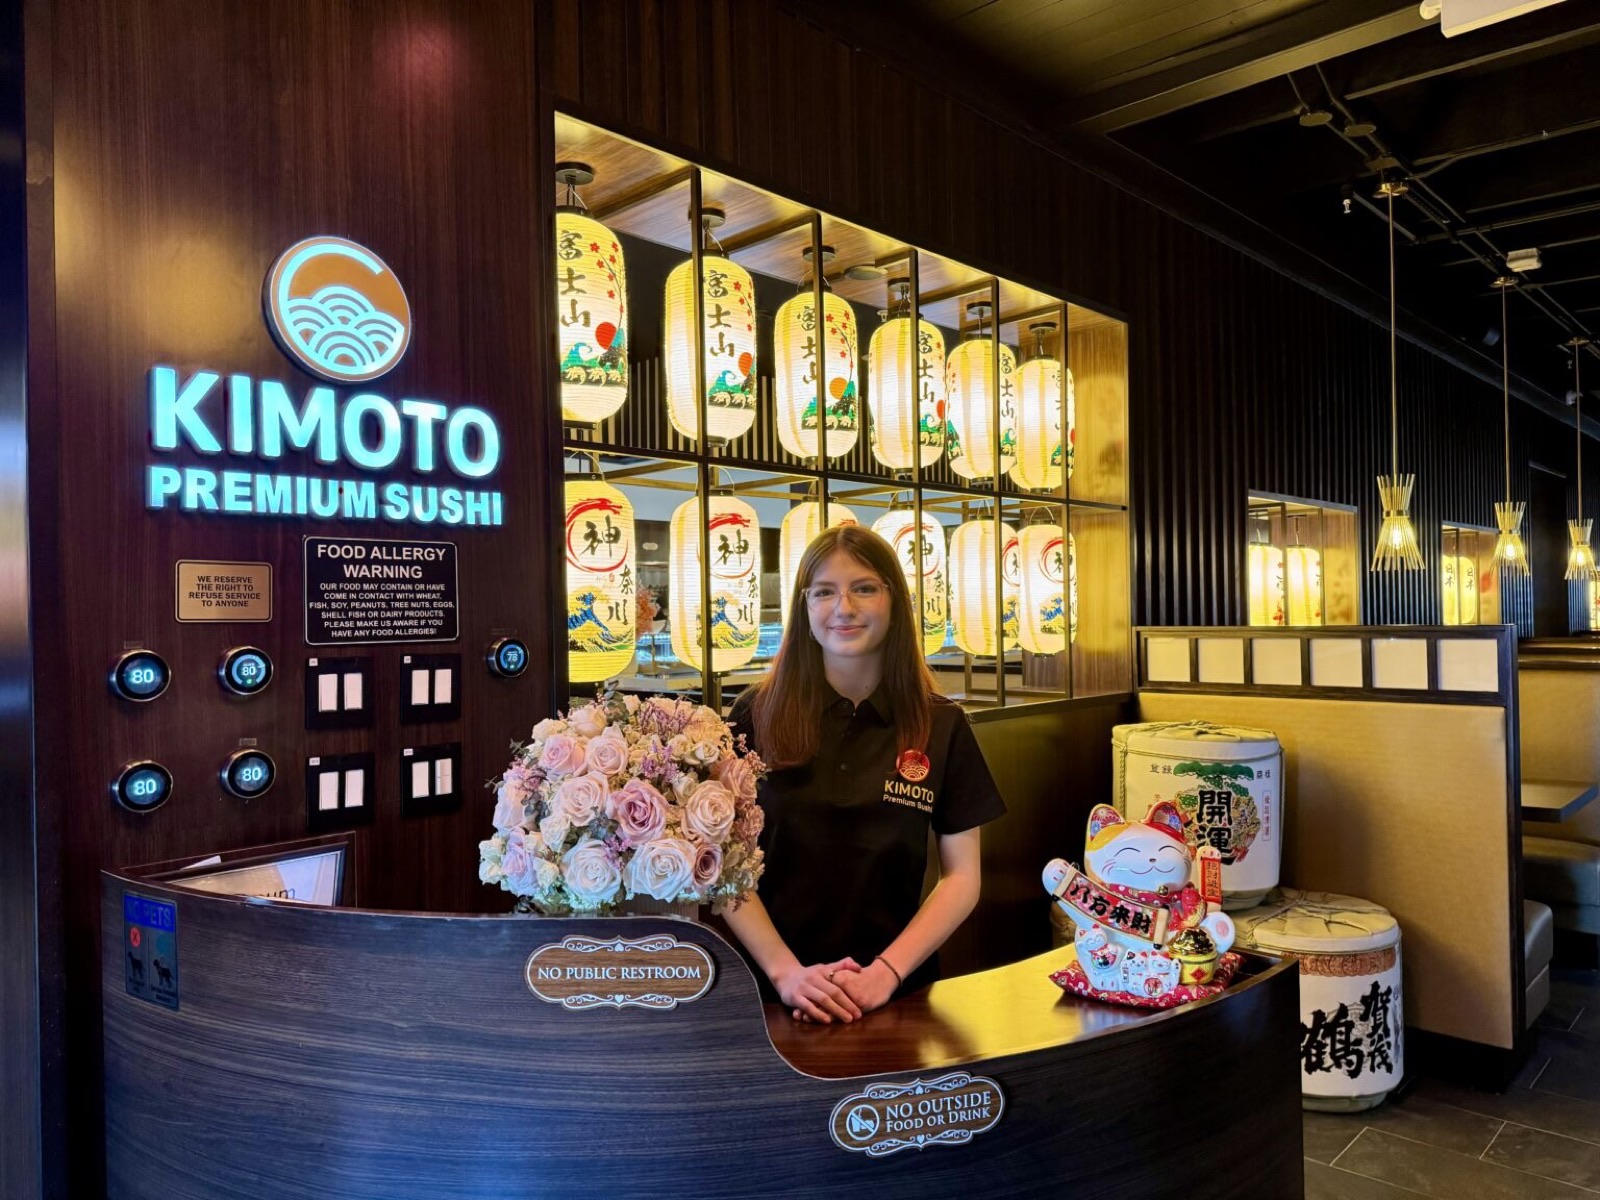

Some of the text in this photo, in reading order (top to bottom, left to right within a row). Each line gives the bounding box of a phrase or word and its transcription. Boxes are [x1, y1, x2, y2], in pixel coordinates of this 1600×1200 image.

[558, 230, 591, 328] 富士山
[704, 270, 735, 358] 富士山
[151, 366, 500, 478] KIMOTO
[147, 466, 503, 526] PREMIUM SUSHI
[317, 544, 446, 560] FOOD ALLERGY
[344, 564, 423, 578] WARNING
[381, 583, 412, 591] CONTAIN
[131, 669, 154, 684] 80
[242, 666, 257, 676] 80
[242, 767, 263, 782] 80
[133, 778, 157, 796] 80
[884, 780, 934, 803] KIMOTO
[883, 794, 933, 813] Premium Sushi
[537, 966, 701, 980] NO PUBLIC RESTROOM
[886, 1091, 992, 1120] NO OUTSIDE
[886, 1107, 991, 1132] FOOD OR DRINK
